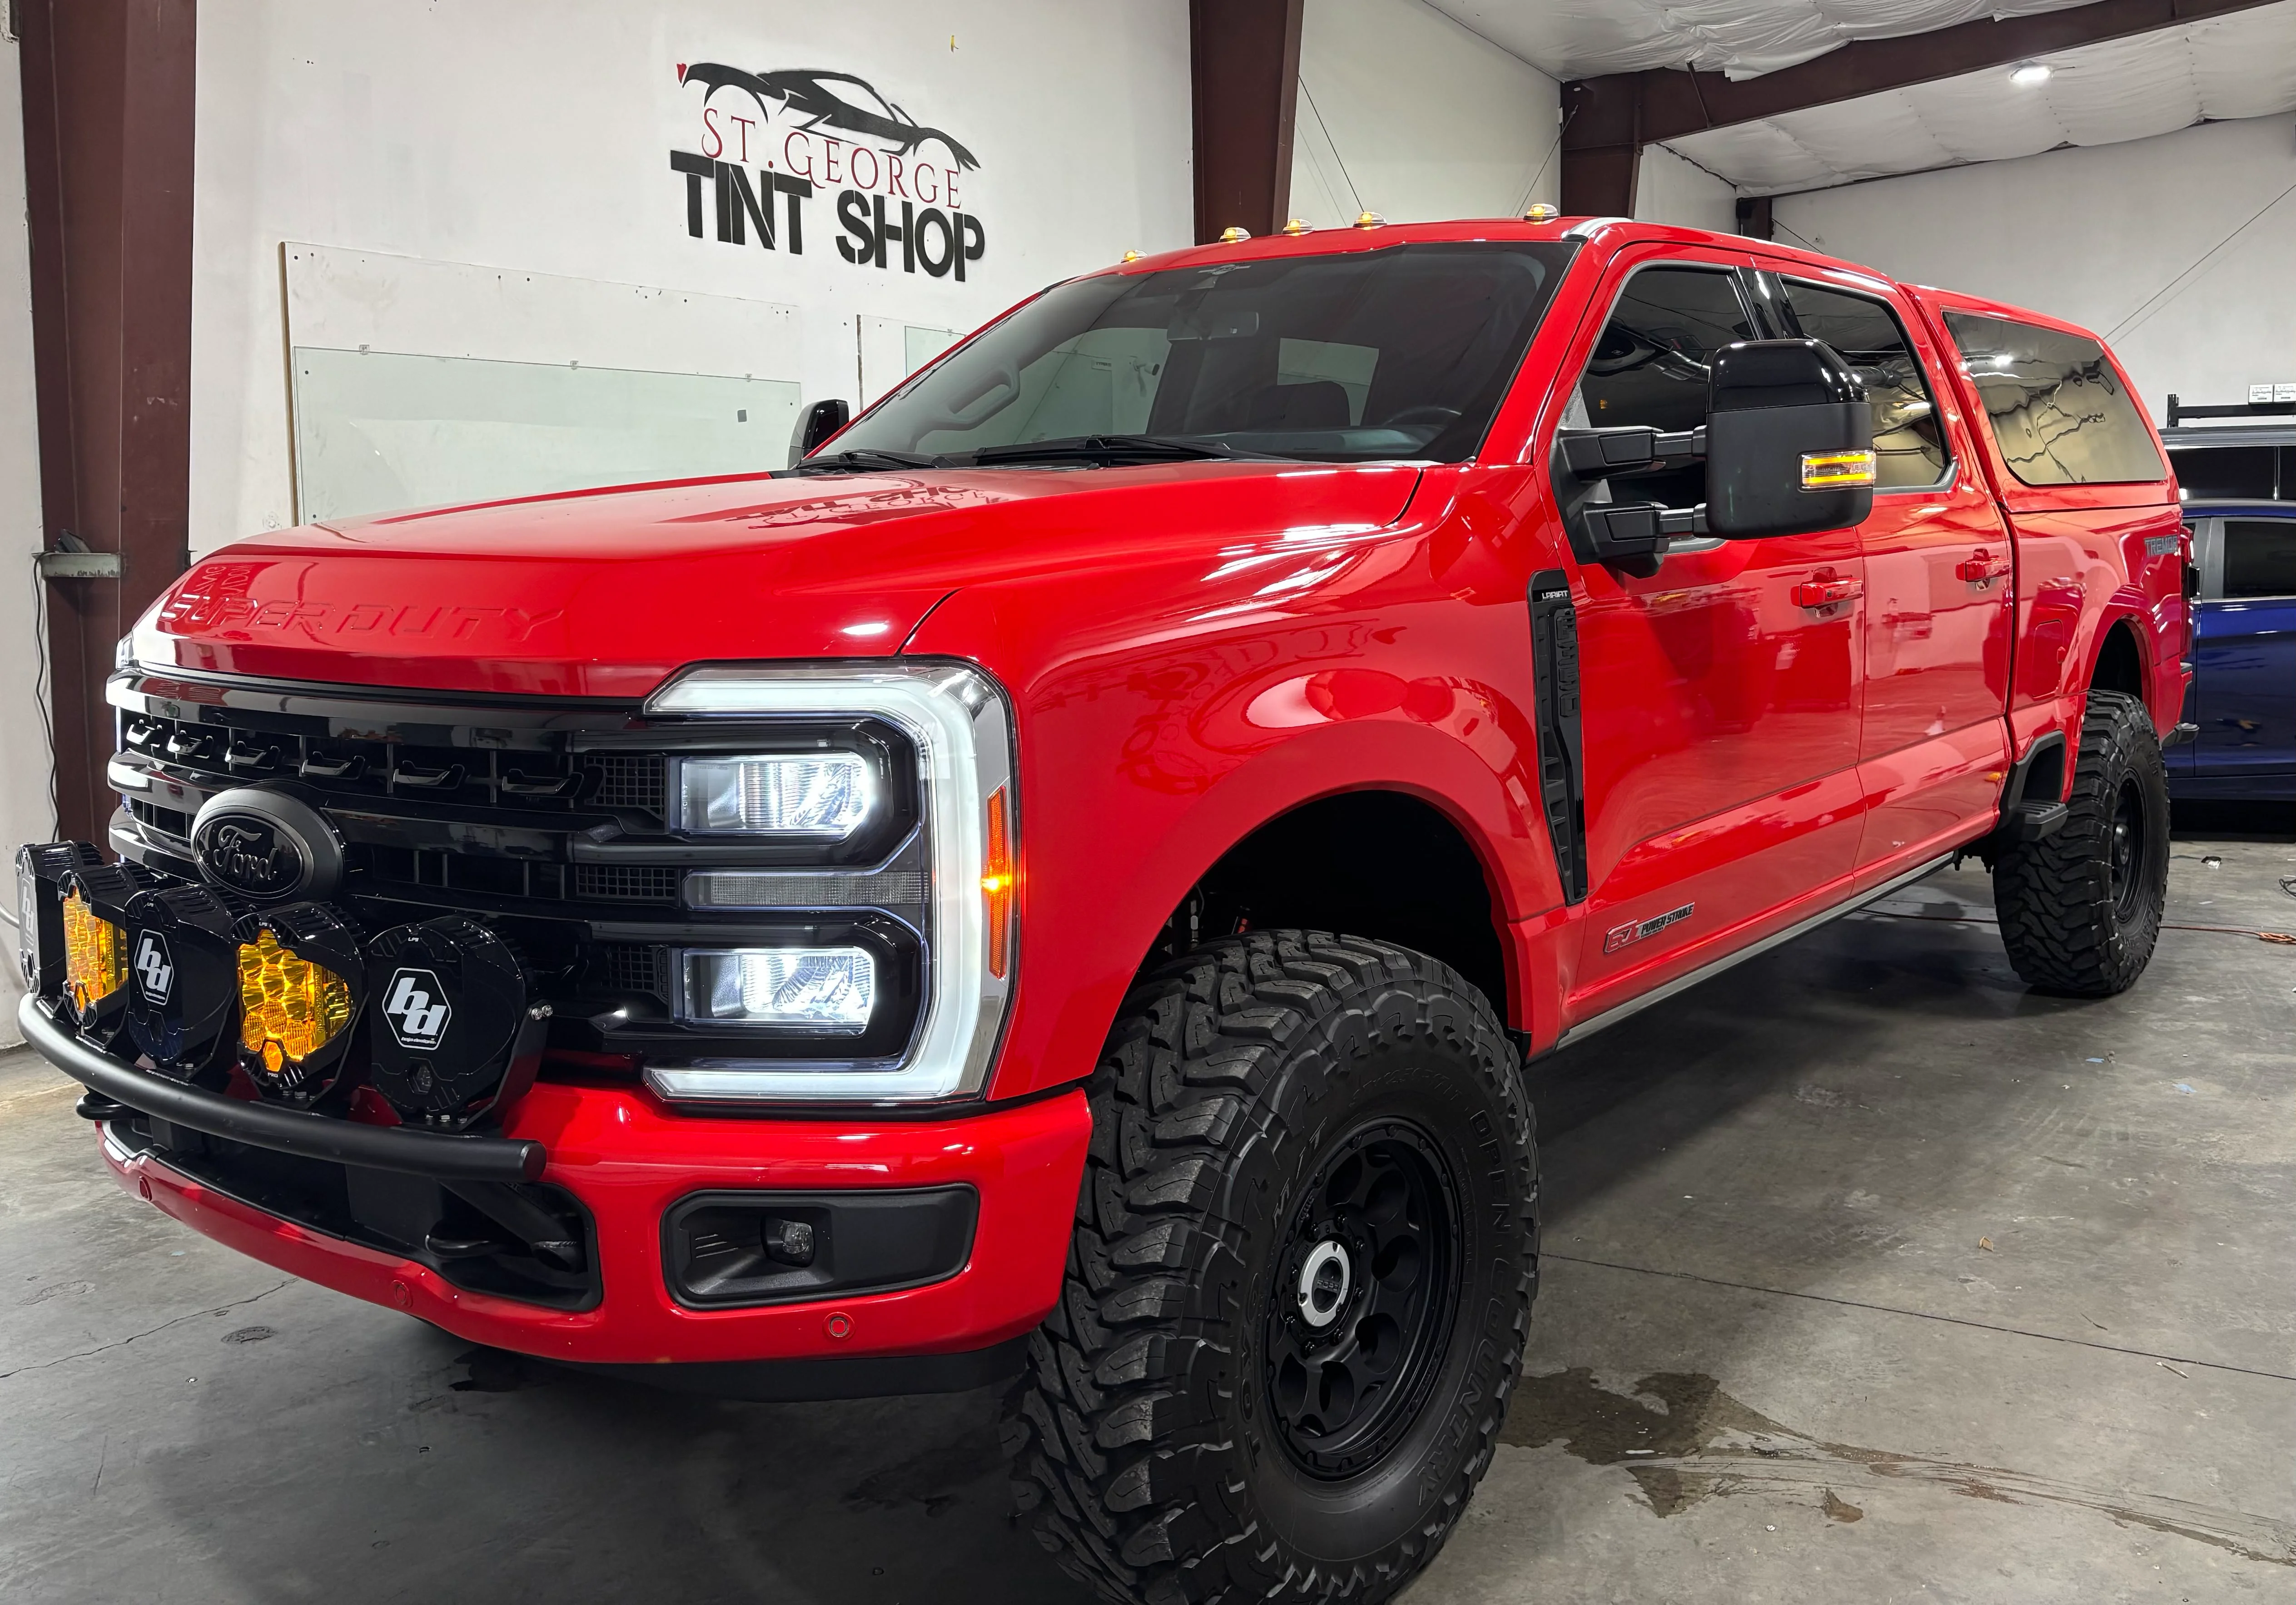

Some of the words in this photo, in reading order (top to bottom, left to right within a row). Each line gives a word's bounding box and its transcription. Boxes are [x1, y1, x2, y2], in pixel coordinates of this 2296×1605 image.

[701, 108, 774, 168] ST.
[785, 132, 961, 208] GEORGE
[671, 150, 812, 255] TINT
[835, 190, 984, 282] SHOP
[2145, 535, 2177, 558] TREMOR
[157, 594, 335, 635] SUPER
[335, 604, 564, 641] DUTY
[213, 825, 278, 880] Ford
[1641, 915, 1667, 934] POWER
[1666, 905, 1694, 924] STROKE
[1470, 1110, 1511, 1233] OPEN
[1417, 1258, 1510, 1506] COUNTRY
